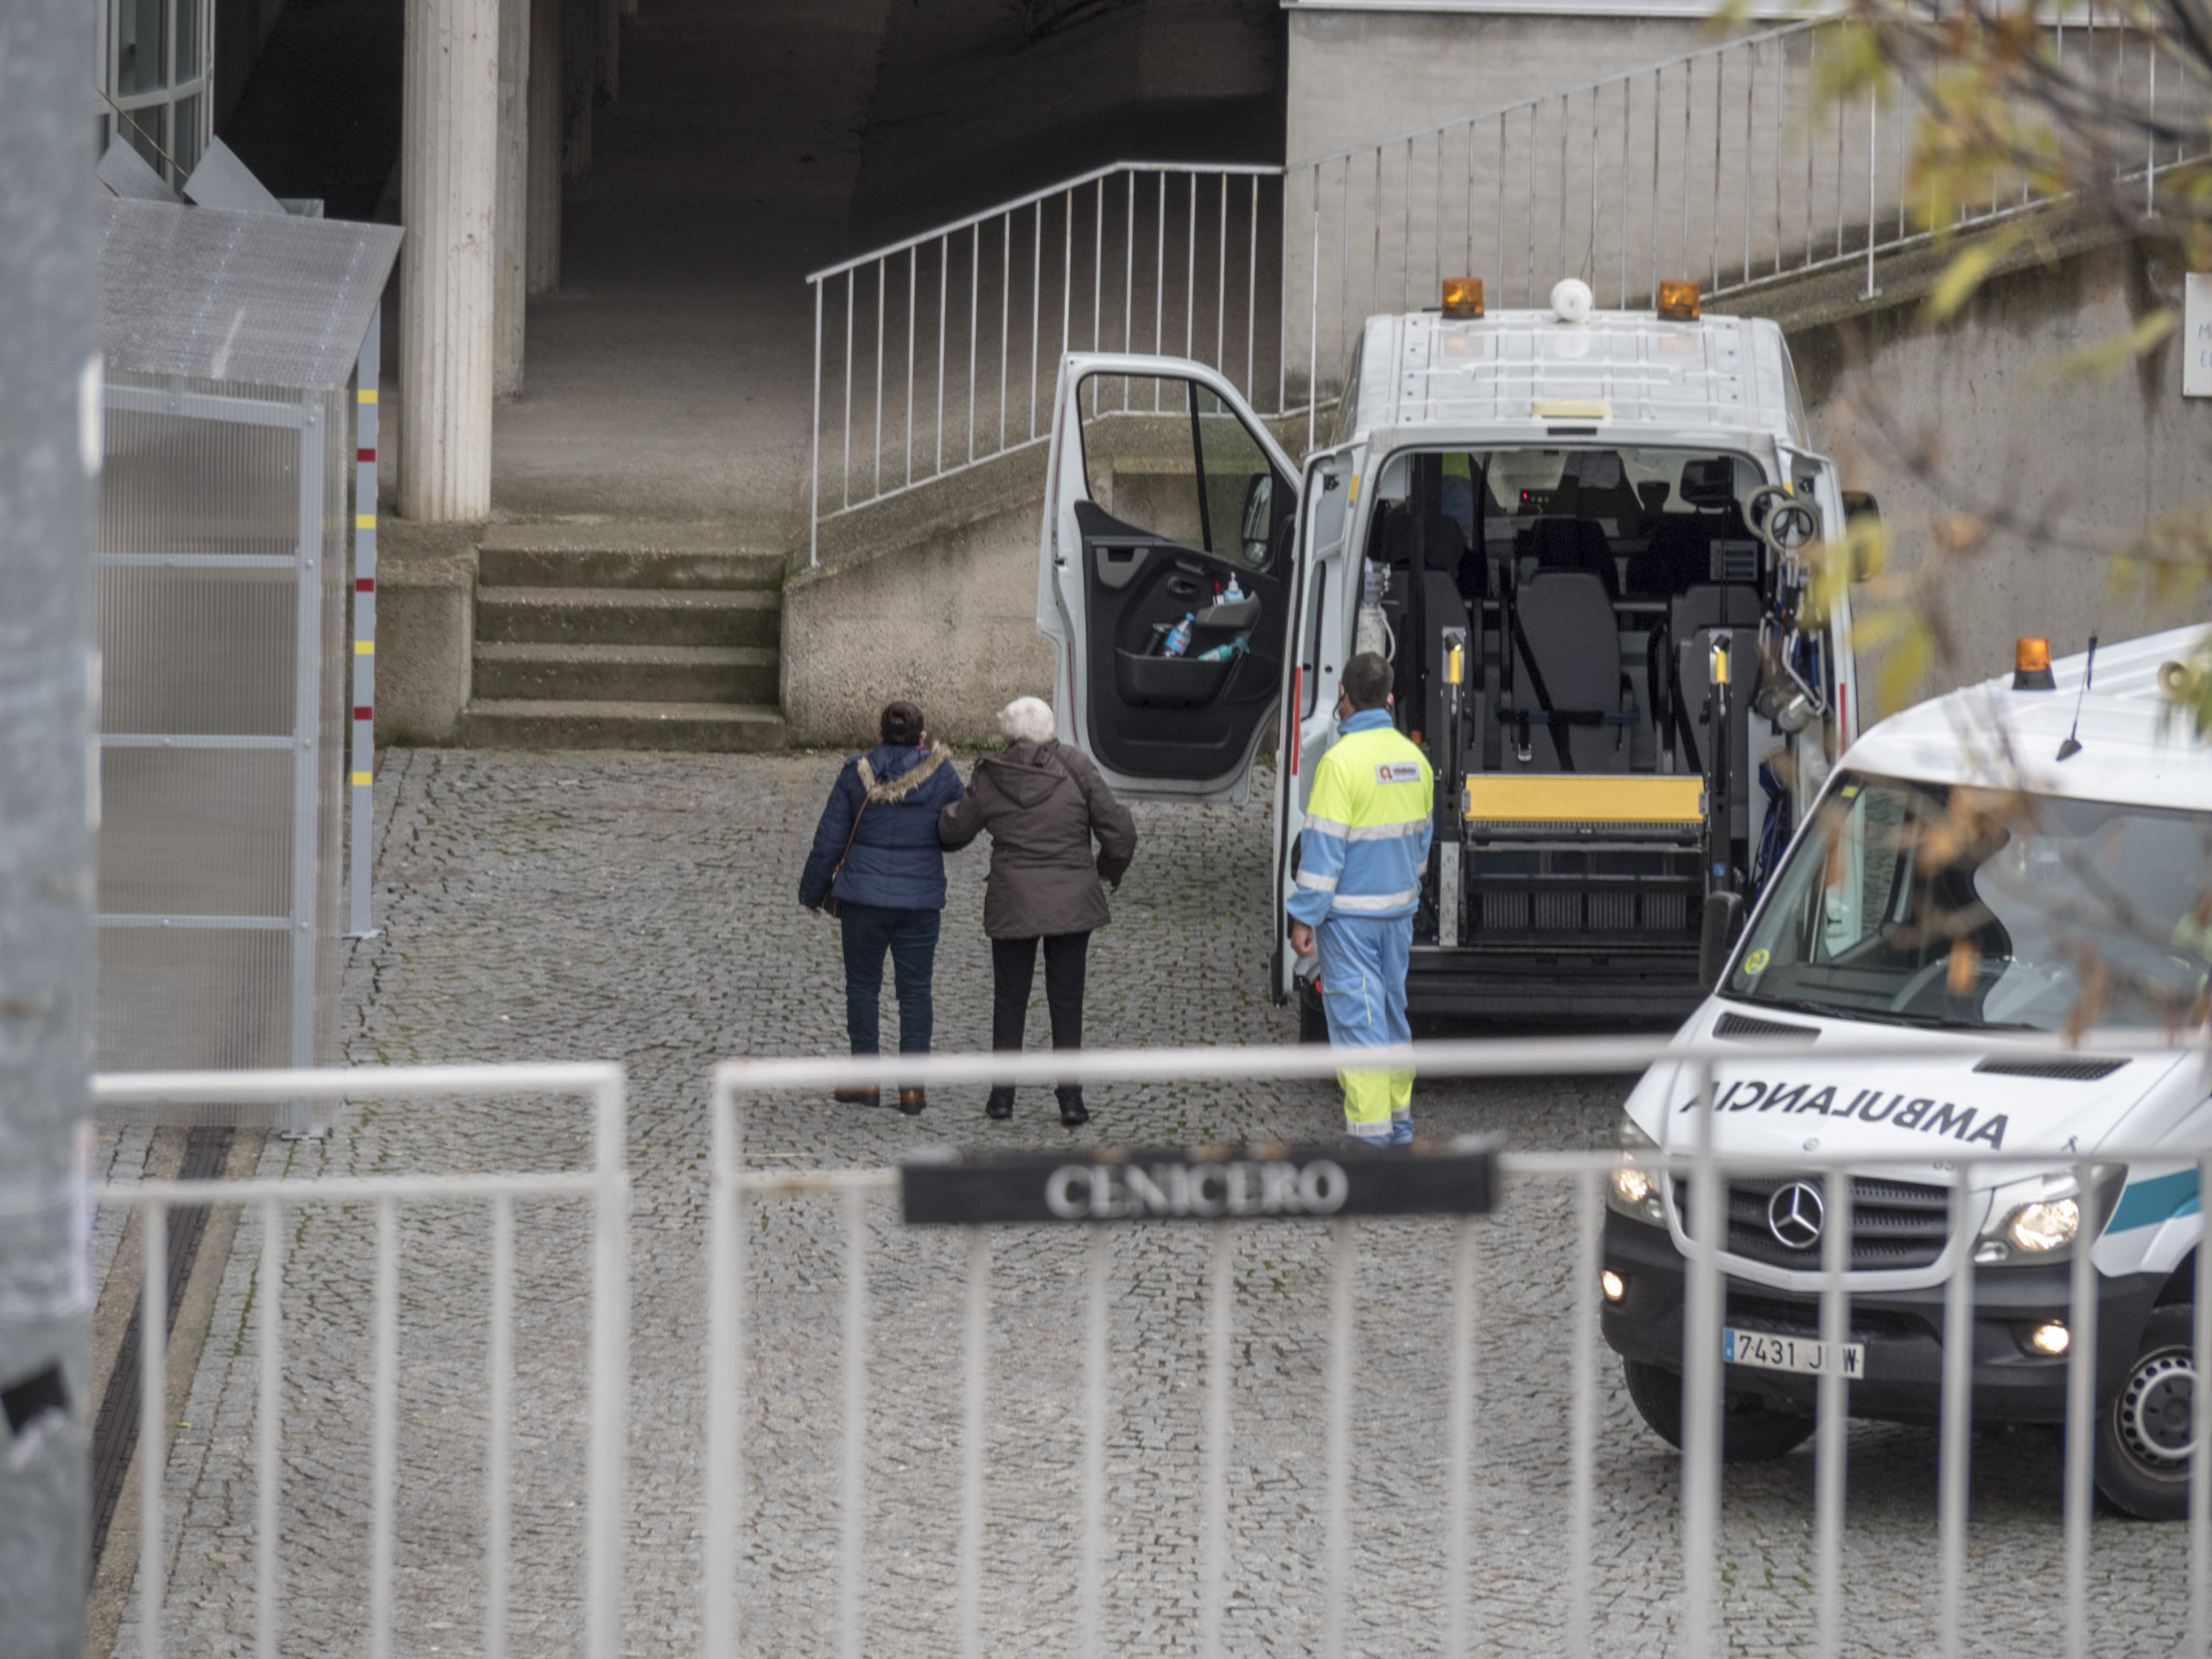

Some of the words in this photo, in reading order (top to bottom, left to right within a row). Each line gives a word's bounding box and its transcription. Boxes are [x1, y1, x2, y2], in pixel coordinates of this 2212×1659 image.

[1045, 1160, 1350, 1220] CENICERO
[1738, 1334, 1795, 1367] 7431
[1808, 1344, 1857, 1373] JW
